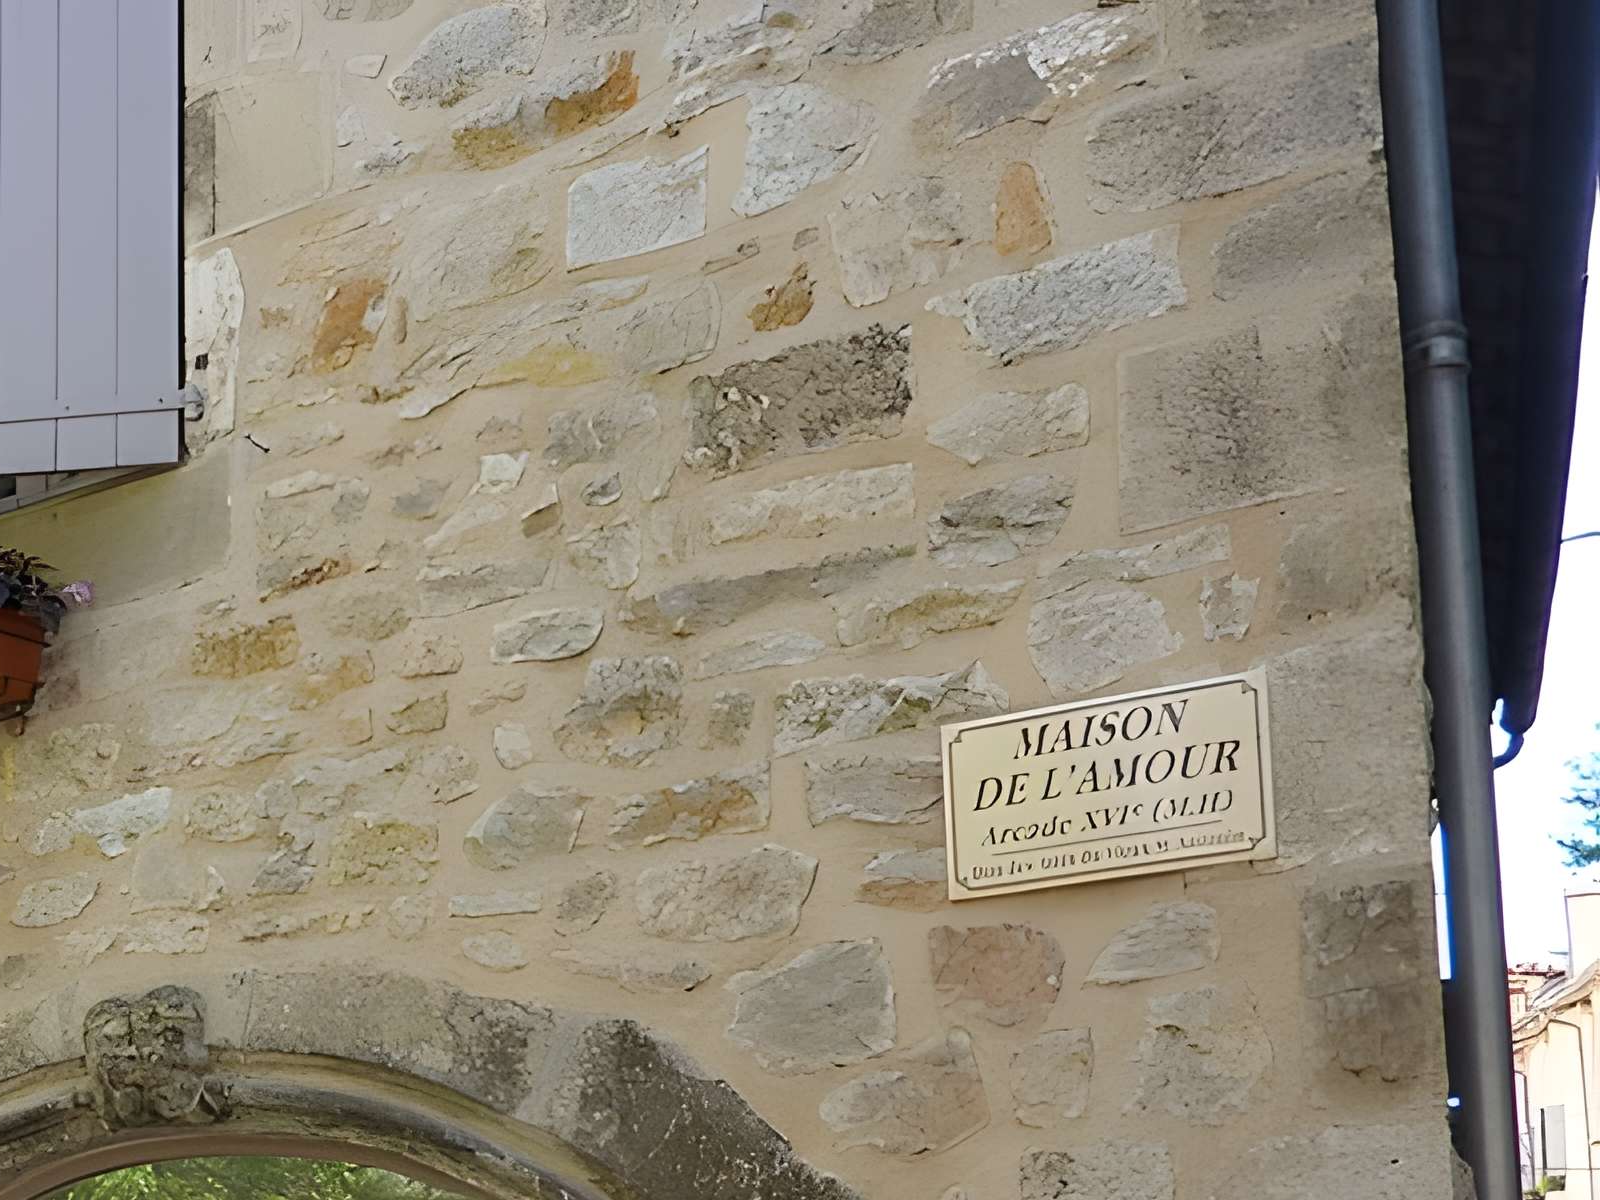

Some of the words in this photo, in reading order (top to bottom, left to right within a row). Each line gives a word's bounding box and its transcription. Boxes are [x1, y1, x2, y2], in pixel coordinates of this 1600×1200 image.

[1013, 699, 1189, 760] MAISON
[973, 772, 1029, 812] DE
[1042, 739, 1241, 802] L'AMOUR
